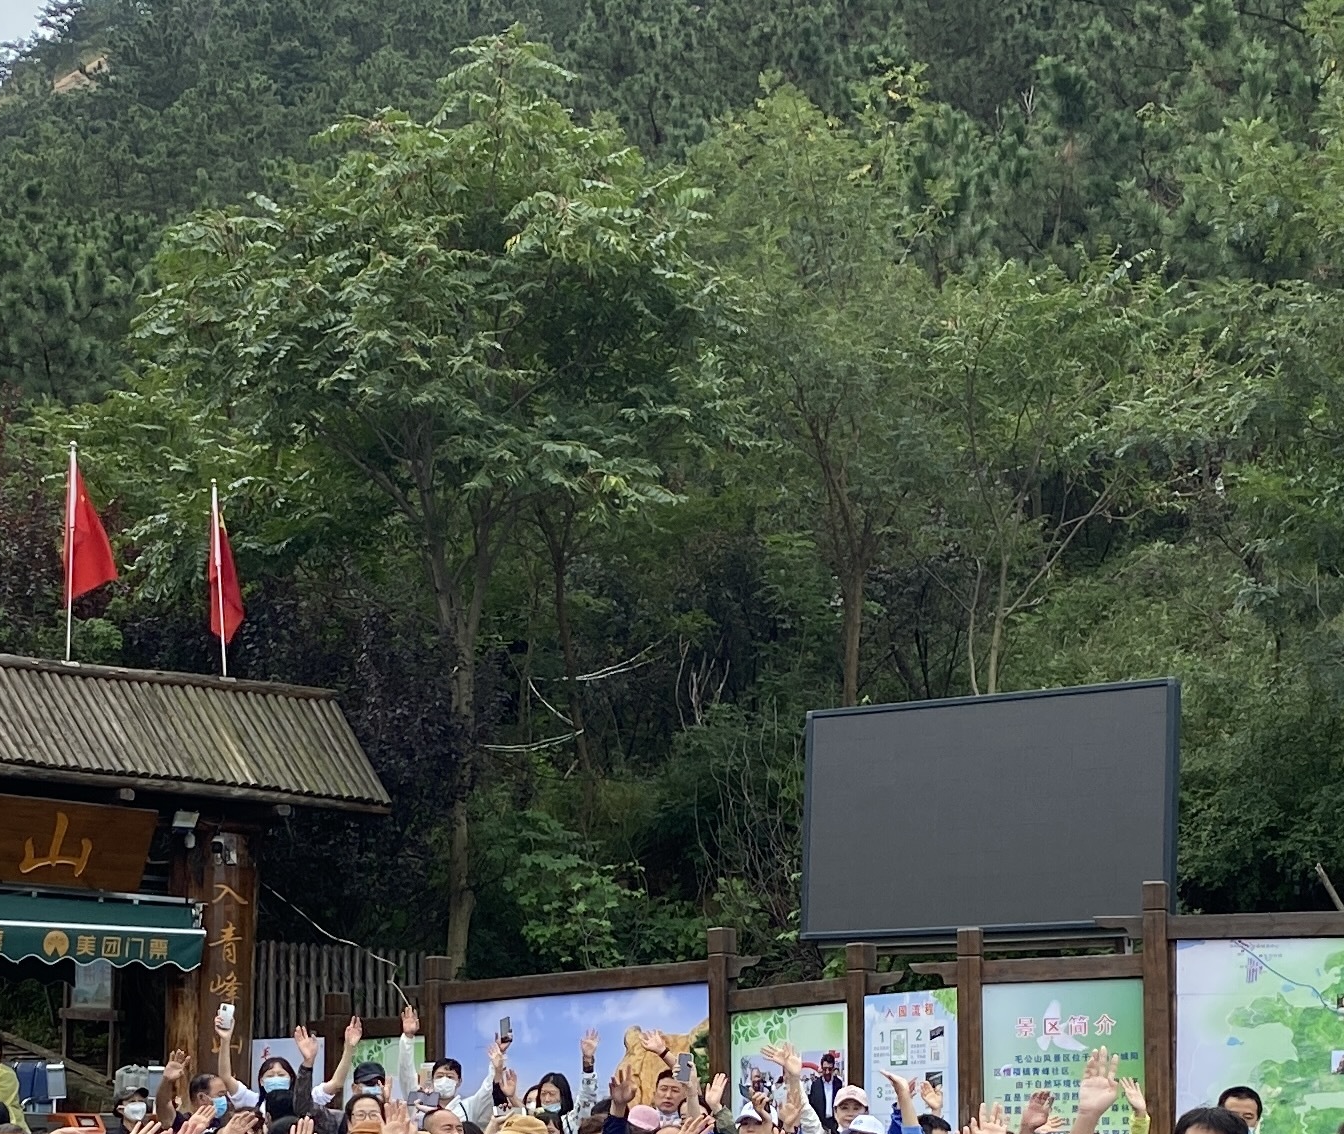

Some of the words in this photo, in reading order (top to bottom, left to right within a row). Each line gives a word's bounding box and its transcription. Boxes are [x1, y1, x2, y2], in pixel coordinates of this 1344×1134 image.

[76, 934, 169, 960] 美团门票
[1015, 1014, 1116, 1037] 景区简介
